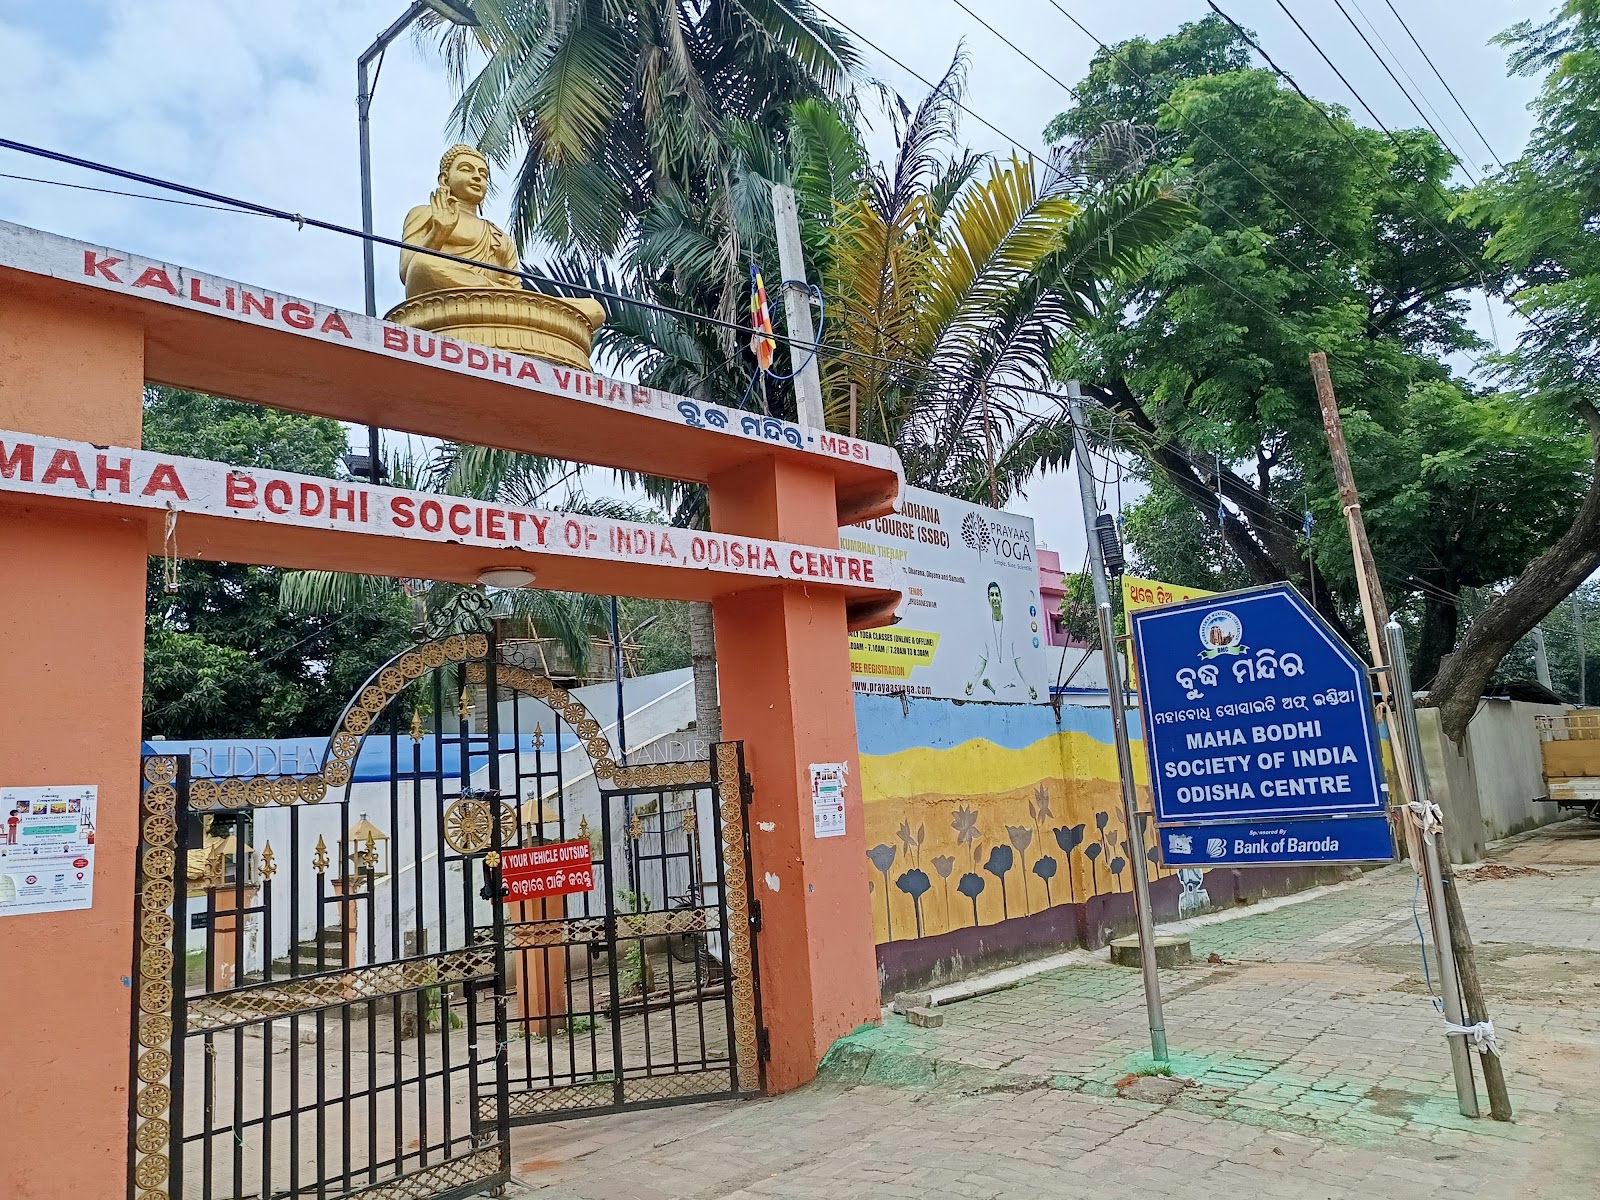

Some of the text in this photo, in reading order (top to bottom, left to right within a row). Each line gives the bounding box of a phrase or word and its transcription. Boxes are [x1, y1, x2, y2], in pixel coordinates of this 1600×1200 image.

[84, 250, 353, 340] KALINGA
[383, 326, 542, 384] BUDDHA
[820, 434, 870, 461] MBSI
[0, 440, 190, 501] MAHA
[226, 472, 368, 522] BODHI
[390, 496, 551, 545] SOCIETY
[564, 519, 598, 550] OF
[789, 549, 875, 583] CENTRE
[897, 501, 941, 525] ADHANA
[875, 517, 915, 540] COURSE
[917, 525, 950, 550] (SSBC)
[990, 522, 1030, 543] PRAYAAS
[840, 537, 908, 562] KUMBHAK THERAPY
[991, 536, 1032, 563] YOGA
[872, 632, 893, 642] CLASSES
[1217, 646, 1229, 654] BMC
[851, 662, 905, 677] REE REGISTRATION
[1175, 664, 1220, 700] ବୁଦ୍ଧ
[1186, 720, 1322, 750] MAHA BODHI
[189, 745, 321, 778] BUDDHA
[1165, 745, 1358, 778] SOCIETY OF INDIA
[1177, 775, 1352, 804] ODISHA CENTRE
[1233, 836, 1339, 855] Bank of Baroda
[1279, 828, 1287, 836] By
[509, 854, 528, 868] YOUR
[529, 849, 558, 865] VEHICLE
[559, 845, 589, 861] OUTSIDE
